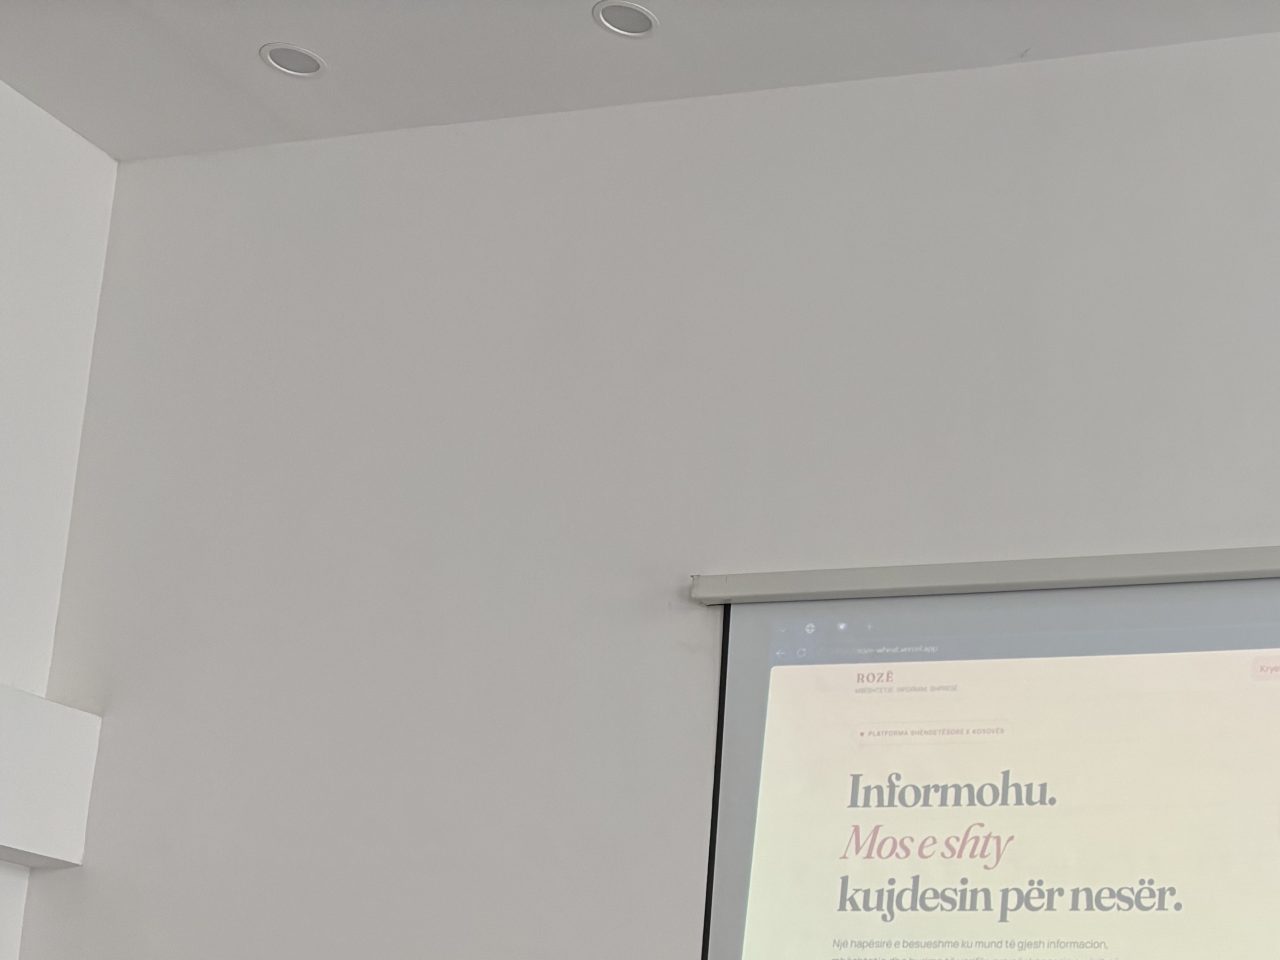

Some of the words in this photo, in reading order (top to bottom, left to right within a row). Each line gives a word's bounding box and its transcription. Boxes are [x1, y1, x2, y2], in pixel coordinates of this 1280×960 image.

[847, 769, 1057, 808] Informohu.
[839, 824, 914, 860] Mos
[918, 836, 938, 860] e
[940, 823, 1014, 870] shty
[837, 875, 993, 923] kujdesin
[998, 879, 1065, 923] për
[1069, 878, 1183, 912] nesër.
[832, 939, 849, 950] Një
[902, 939, 960, 949] besueshme
[961, 939, 973, 949] ku
[975, 940, 1003, 949] mund
[1005, 940, 1015, 949] të
[1017, 940, 1045, 951] gjesh
